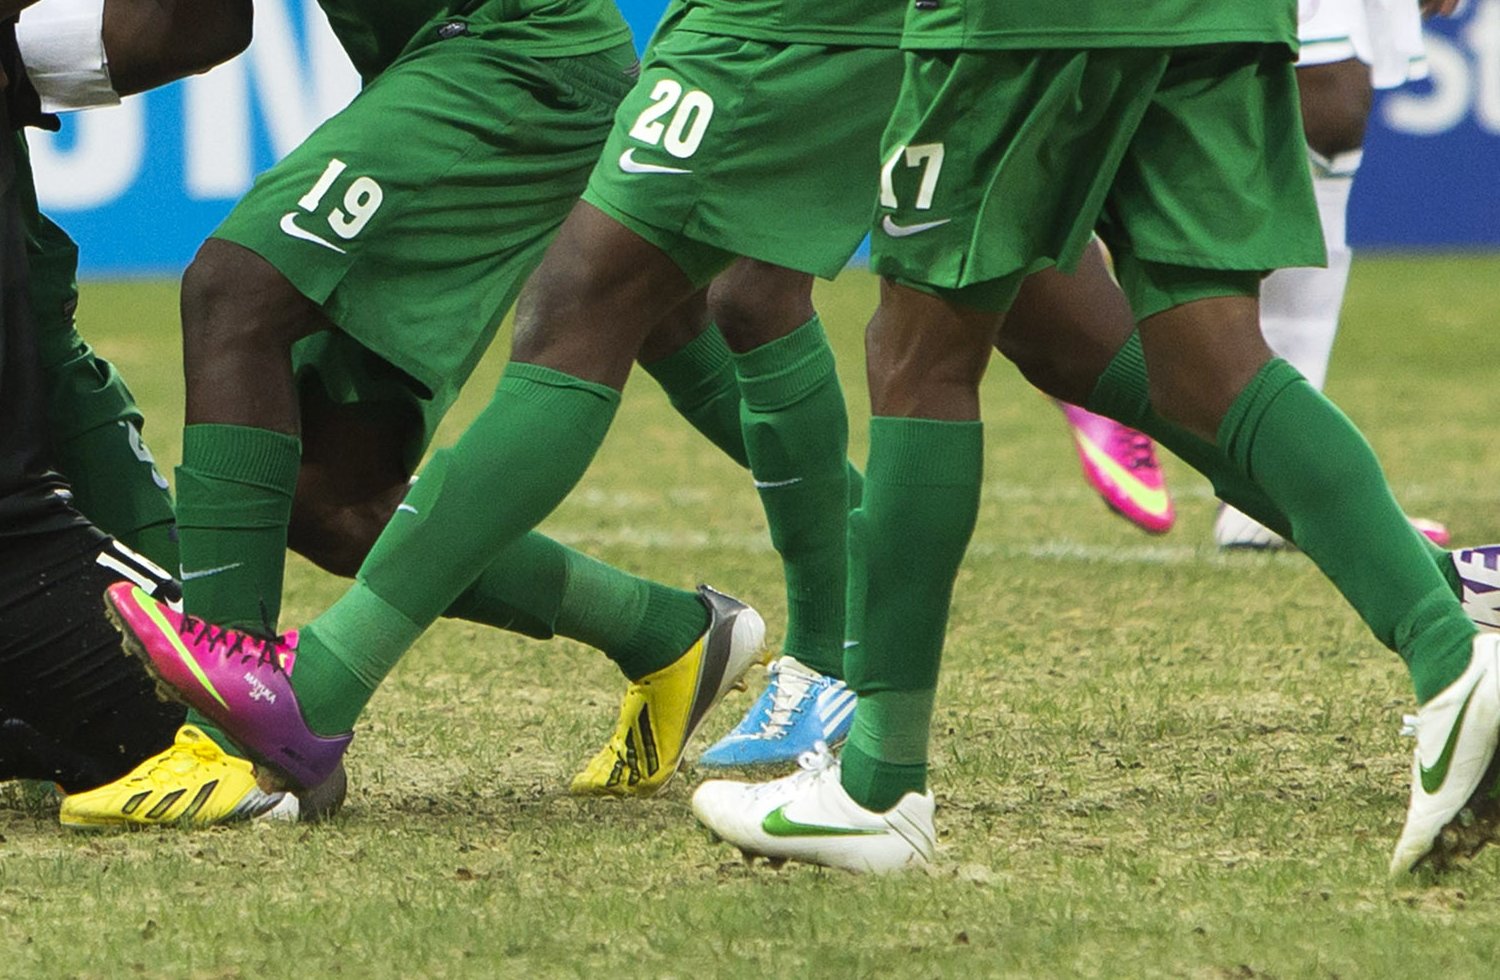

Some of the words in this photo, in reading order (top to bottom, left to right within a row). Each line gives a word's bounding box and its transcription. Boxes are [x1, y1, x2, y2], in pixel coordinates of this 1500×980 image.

[629, 80, 714, 158] 20
[298, 159, 383, 239] 19
[880, 142, 944, 210] 17
